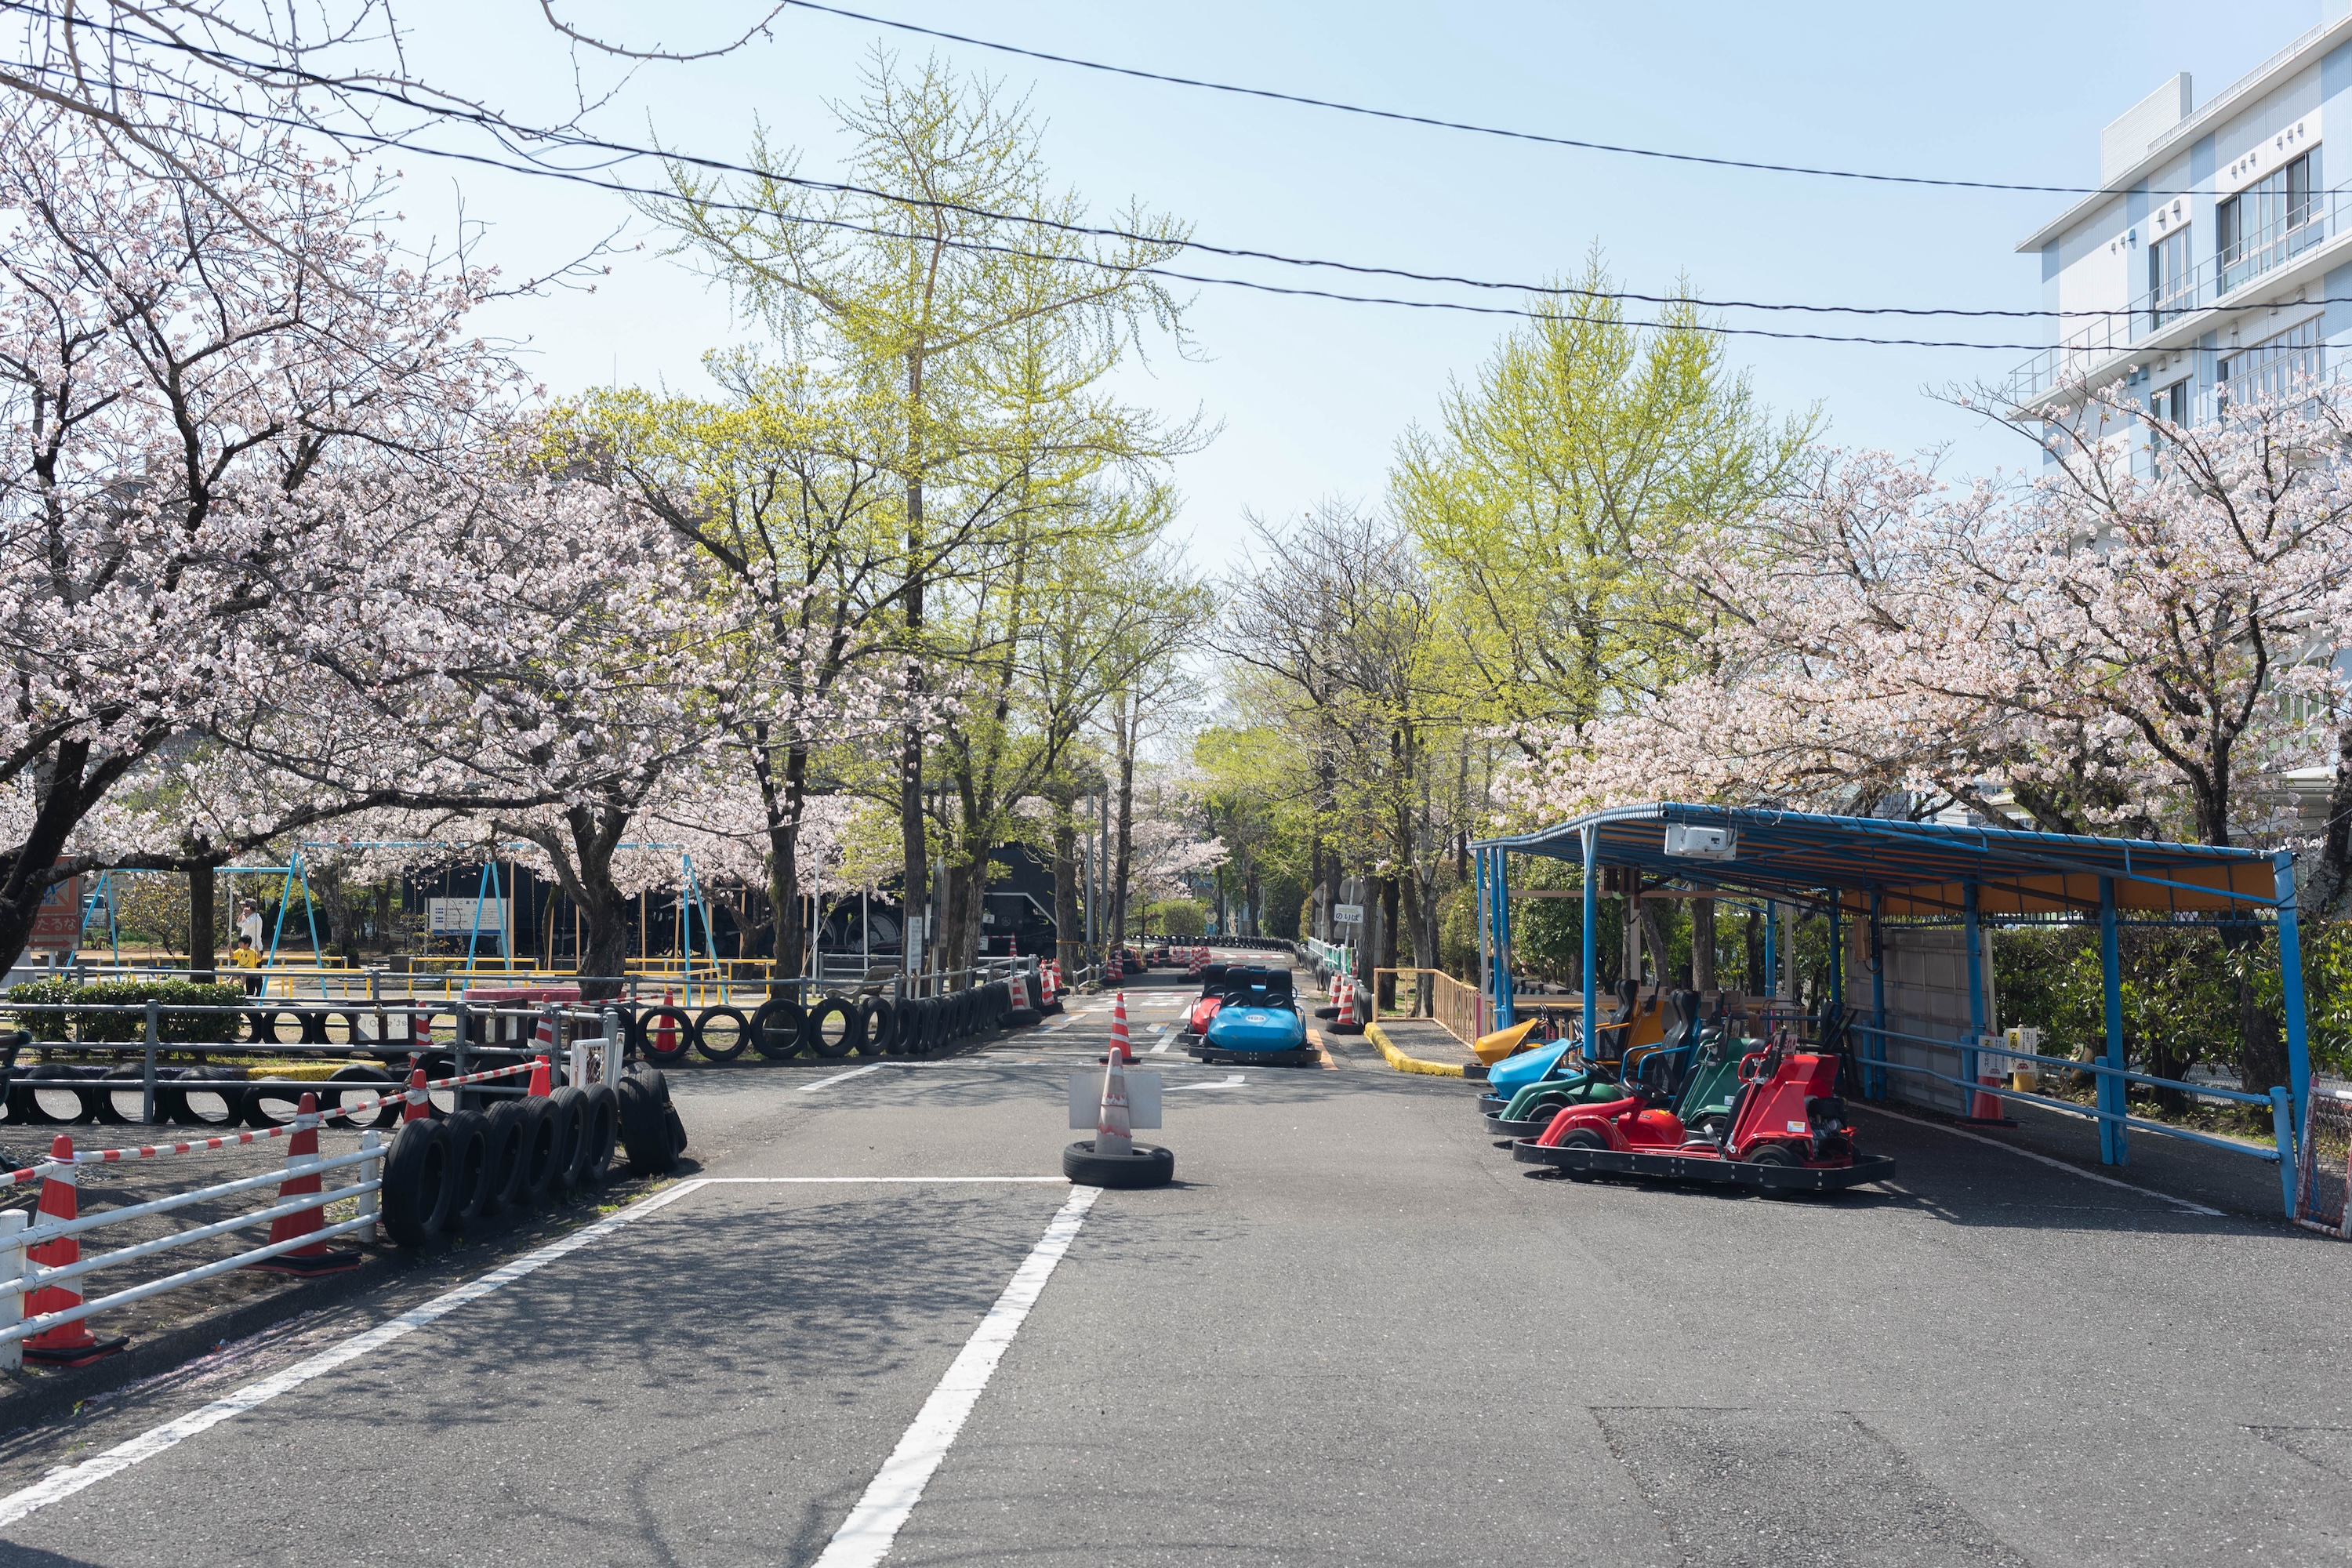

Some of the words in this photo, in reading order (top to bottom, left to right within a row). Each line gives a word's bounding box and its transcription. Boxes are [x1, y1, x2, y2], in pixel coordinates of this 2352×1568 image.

[1336, 913, 1360, 922] のりば
[32, 918, 76, 931] たるな
